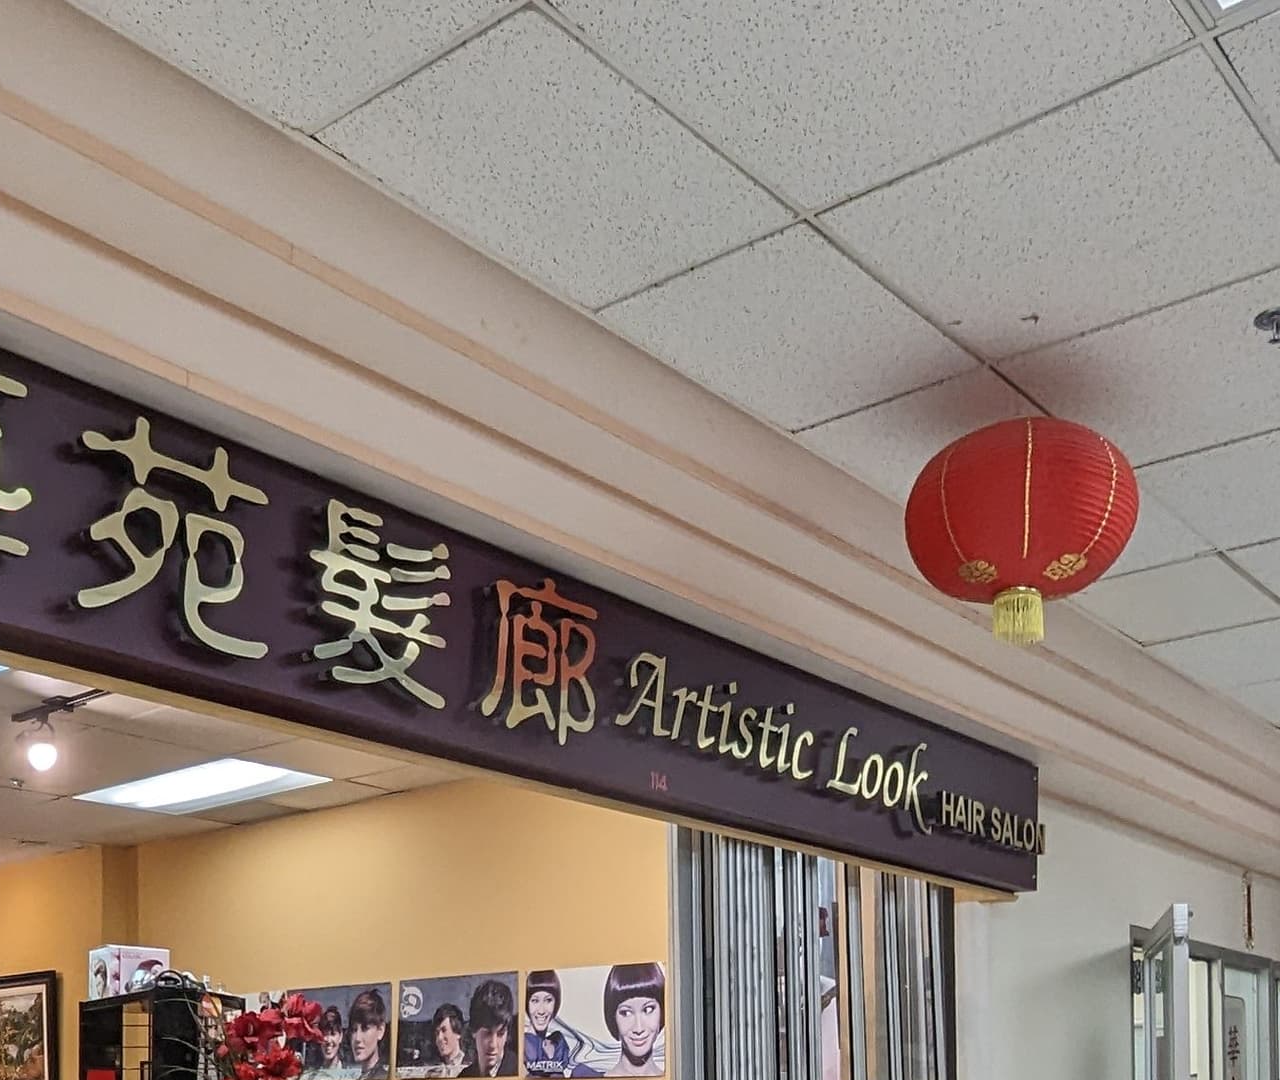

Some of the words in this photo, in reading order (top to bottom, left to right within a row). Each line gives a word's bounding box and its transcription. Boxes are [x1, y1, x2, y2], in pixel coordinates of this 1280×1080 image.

[615, 651, 814, 779] Artistic
[826, 727, 931, 834] Look
[940, 791, 985, 836] HAIR
[991, 810, 1046, 855] SALON
[526, 1060, 563, 1071] MATRIX
